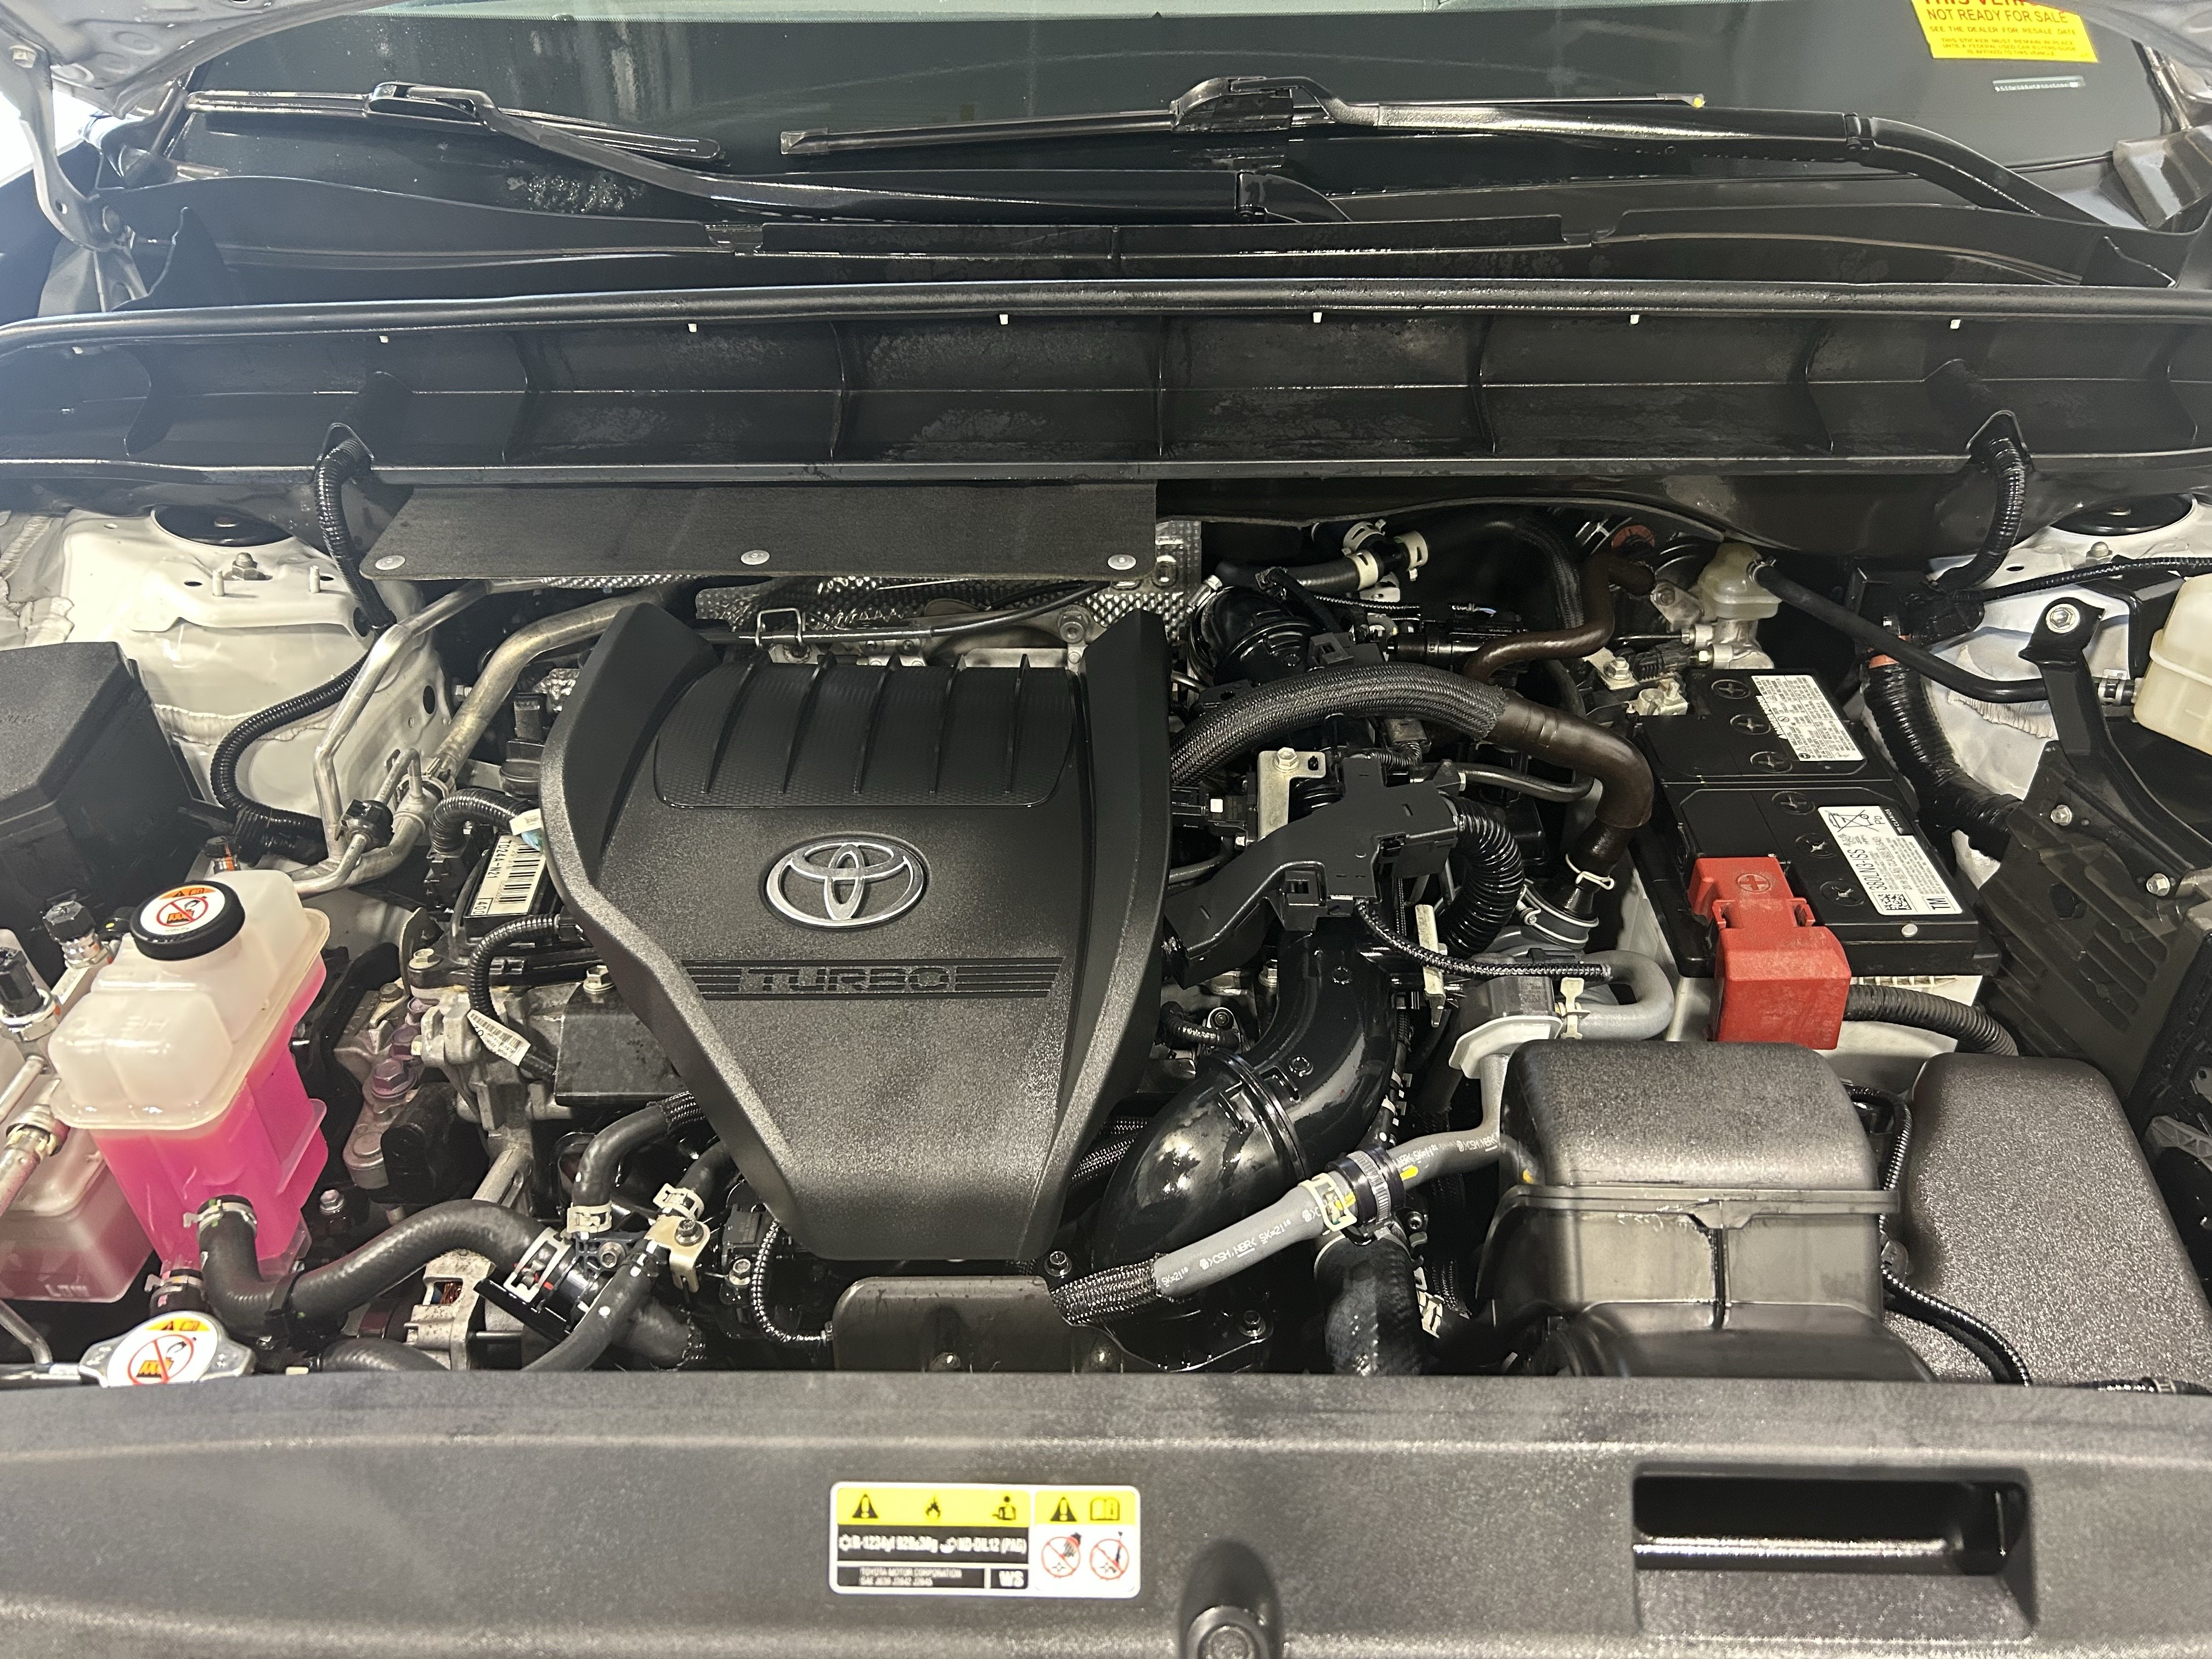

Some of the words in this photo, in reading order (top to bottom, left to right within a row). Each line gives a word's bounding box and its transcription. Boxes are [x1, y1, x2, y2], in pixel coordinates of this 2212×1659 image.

[1927, 9, 1954, 20] NOT
[1957, 9, 2001, 21] READY
[2005, 10, 2032, 22] FOR
[2034, 11, 2068, 23] SALE
[1872, 816, 1885, 824] Pb
[1883, 809, 1900, 826] CLARIOS
[486, 840, 511, 878] TD24A-N21
[1847, 849, 1888, 890] 380LN3-ISS
[473, 901, 488, 914] 400
[1927, 898, 1951, 909] TM
[747, 967, 950, 992] TURBO
[860, 1567, 887, 1576] TOYOTA
[888, 1567, 913, 1577] MOTOR
[913, 1567, 962, 1579] CORPORATION
[999, 1571, 1024, 1587] WS
